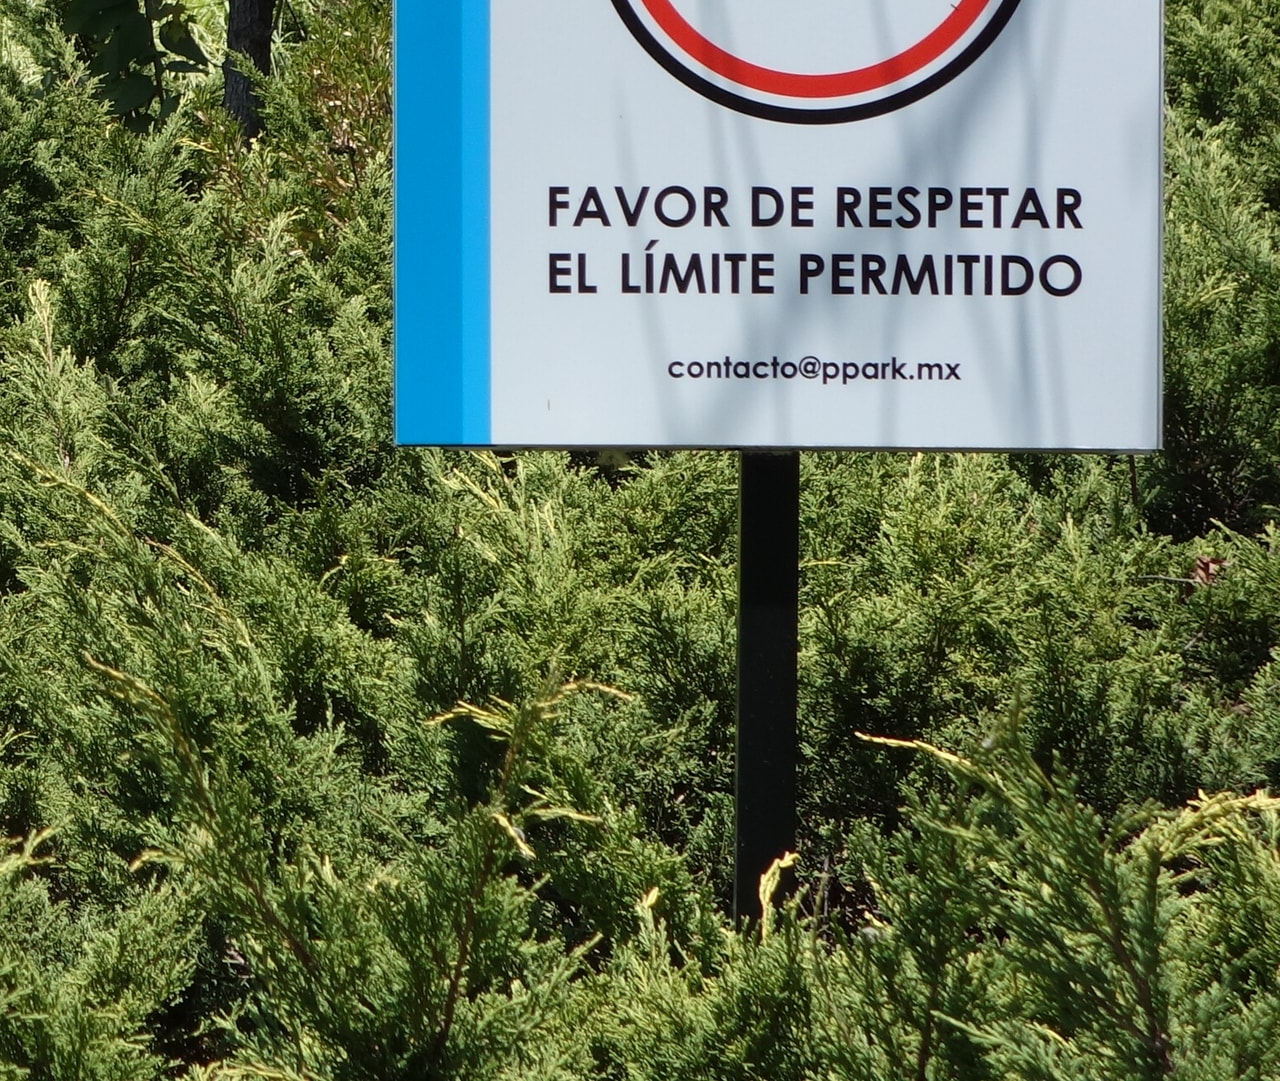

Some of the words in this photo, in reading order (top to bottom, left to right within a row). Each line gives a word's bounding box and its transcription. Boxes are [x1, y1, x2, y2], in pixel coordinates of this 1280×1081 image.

[549, 185, 730, 228] FAVOR
[751, 186, 814, 228] DE
[836, 185, 1083, 229] RESPETAR
[549, 253, 597, 294] EL
[621, 239, 775, 294] LÍMITE
[799, 253, 1083, 297] PERMITIDO
[667, 355, 961, 384] contacto@ppark.mx
